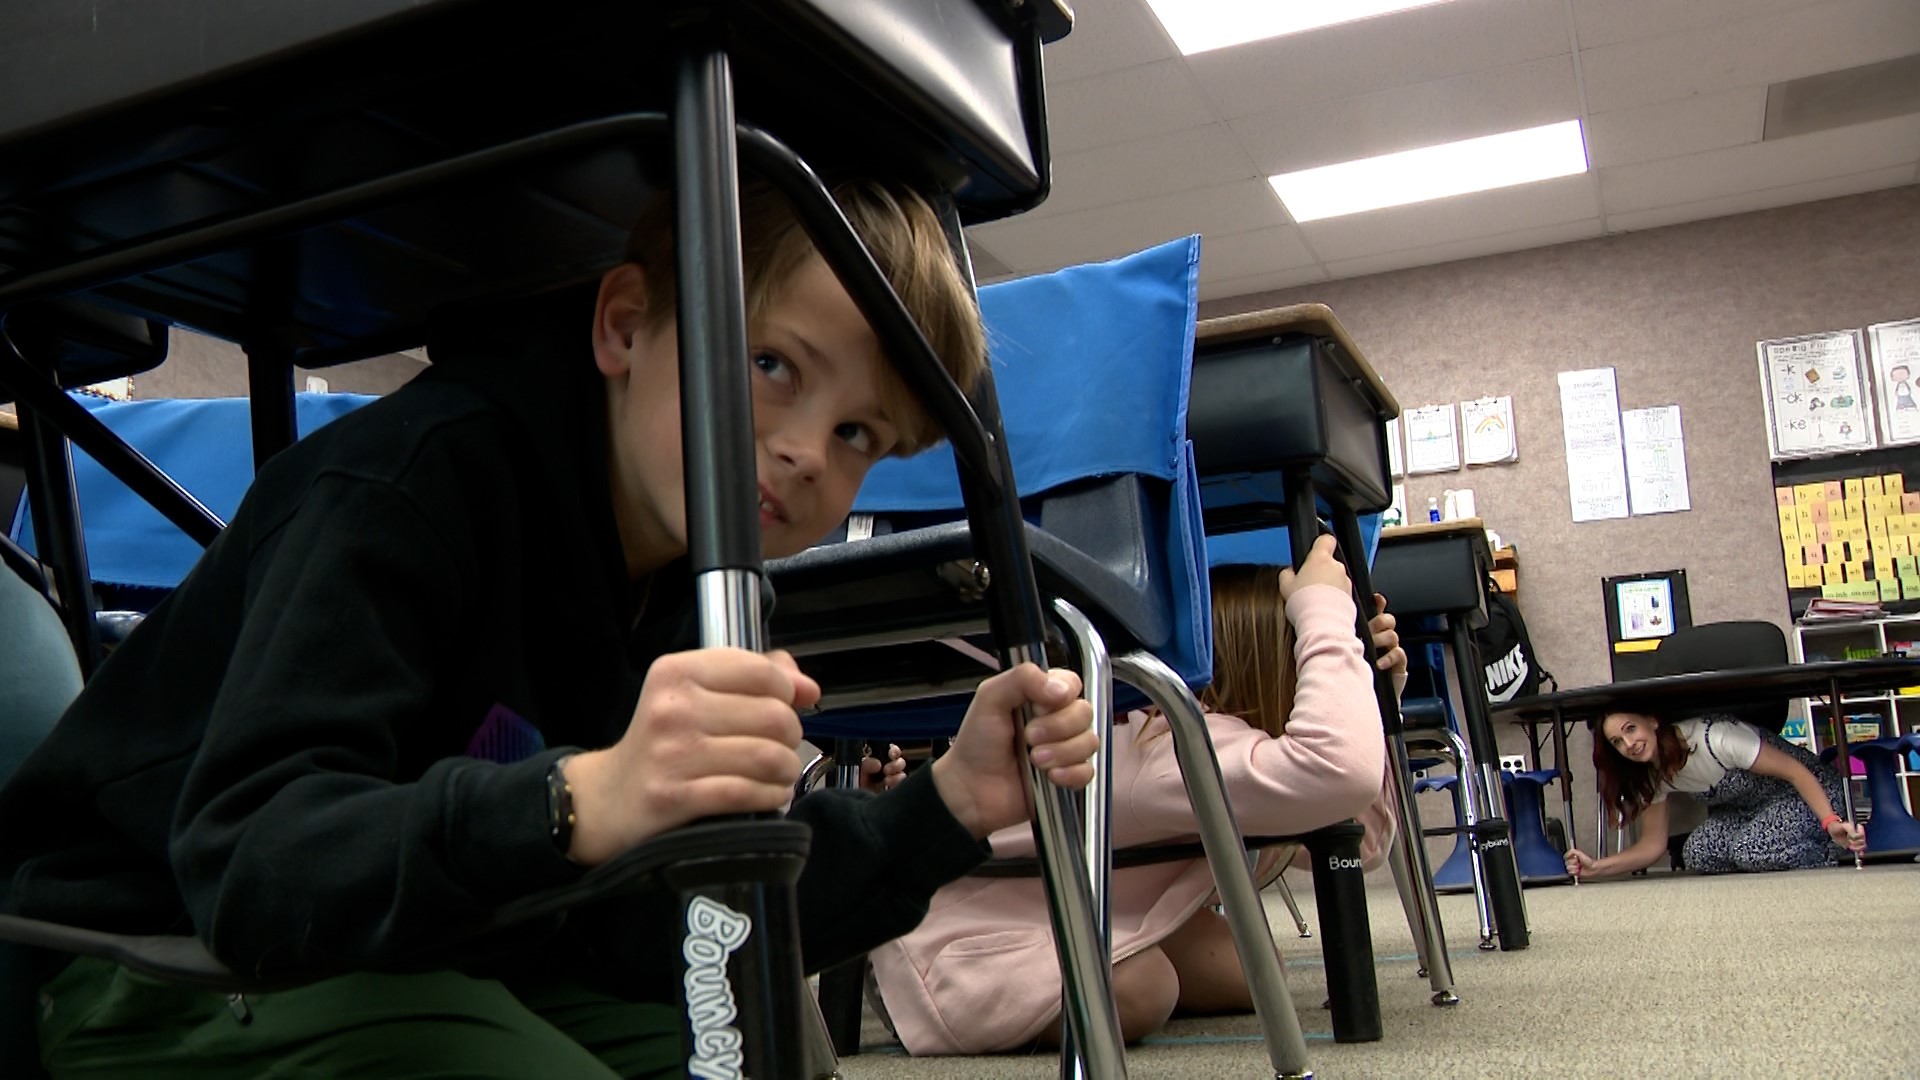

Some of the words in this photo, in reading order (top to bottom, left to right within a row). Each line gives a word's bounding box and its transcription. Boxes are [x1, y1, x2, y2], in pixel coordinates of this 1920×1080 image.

[1485, 643, 1524, 691] NIKE
[1779, 725, 1794, 736] rt
[683, 895, 752, 1080] Bouncy
